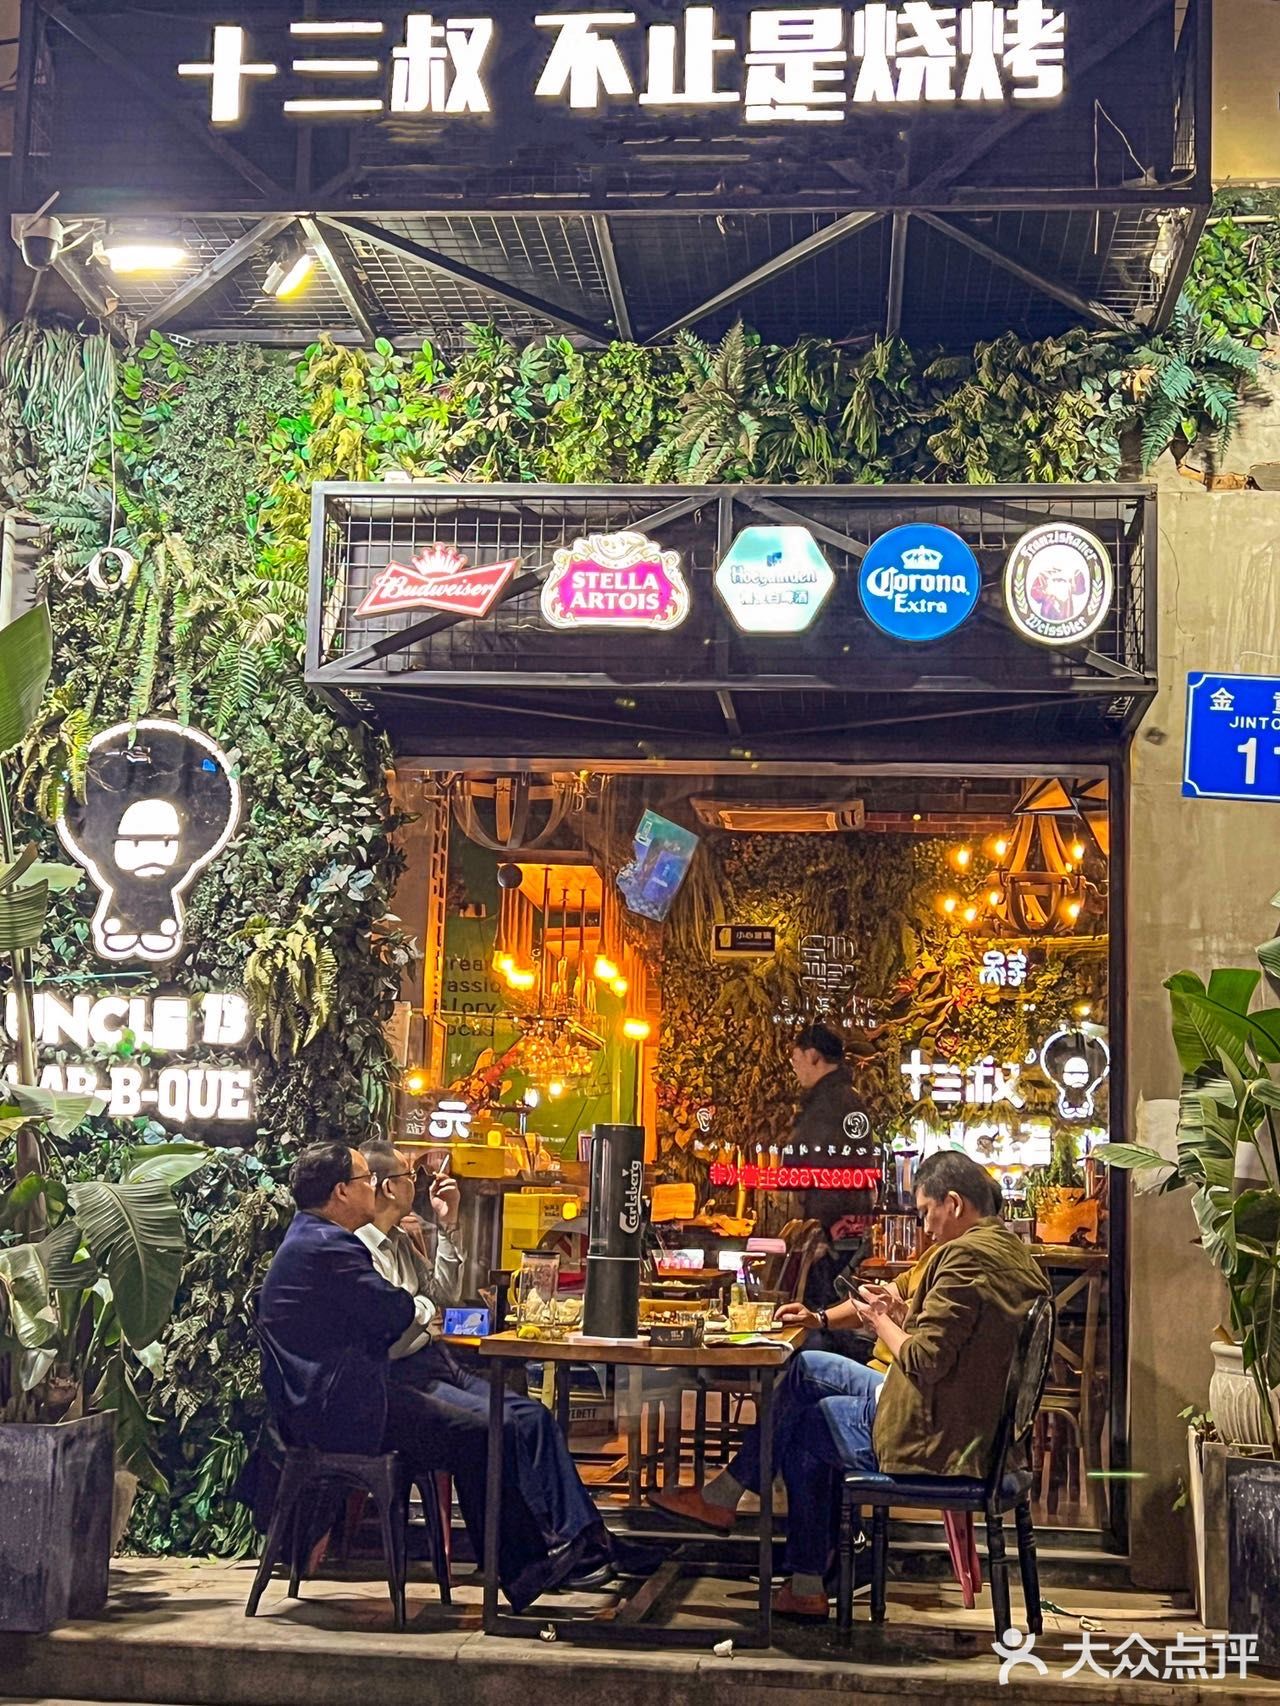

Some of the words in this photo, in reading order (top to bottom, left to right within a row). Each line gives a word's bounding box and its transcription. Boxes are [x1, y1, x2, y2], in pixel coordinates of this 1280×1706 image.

[177, 14, 493, 121] 十三叔
[534, 0, 1065, 122] 不止是烧烤
[1020, 530, 1098, 560] Franziskaner
[376, 575, 494, 599] Budweiser
[572, 571, 659, 590] STELLA
[867, 566, 967, 600] Corona
[570, 592, 660, 610] ARTOIS
[894, 592, 947, 613] Extra
[1025, 613, 1088, 637] Weissbier
[619, 1159, 642, 1234] Carlsberg
